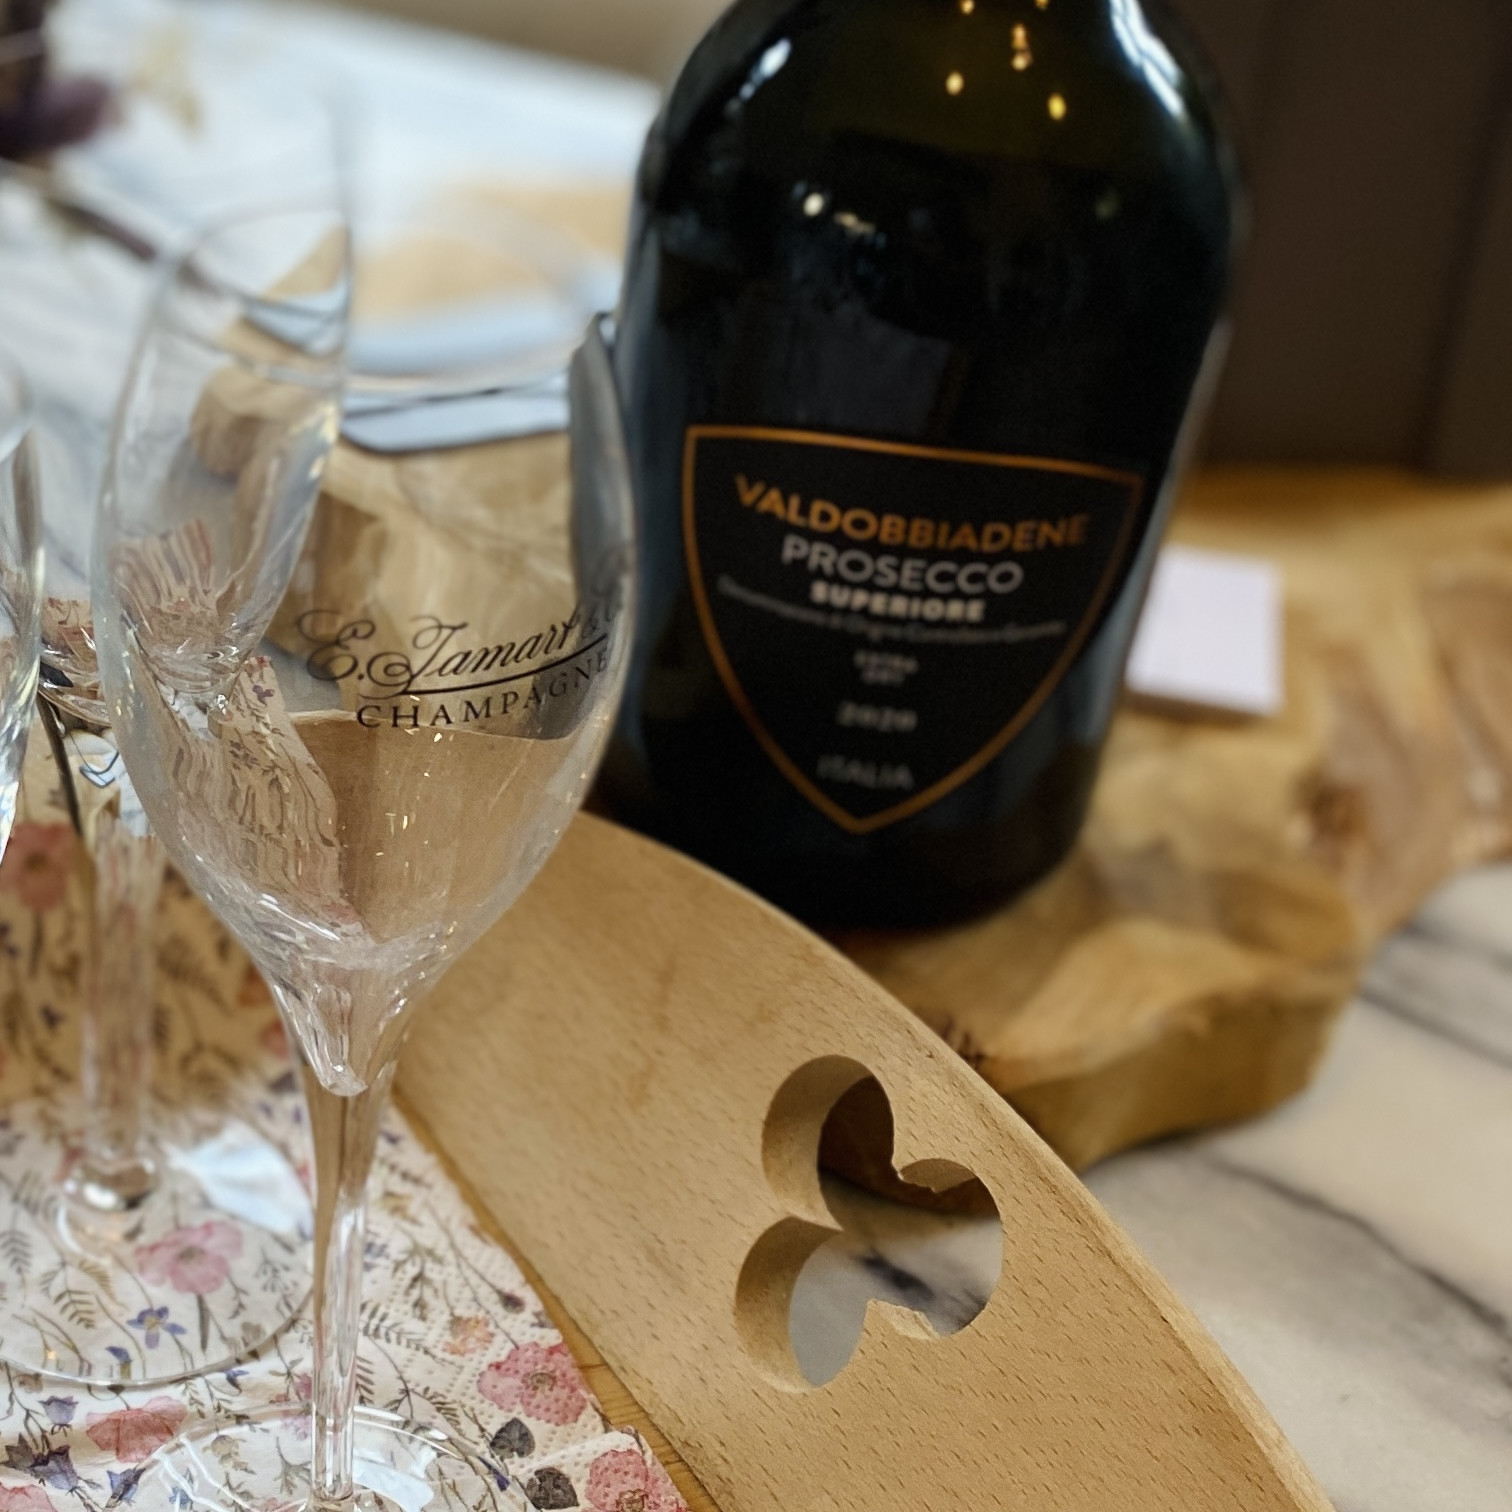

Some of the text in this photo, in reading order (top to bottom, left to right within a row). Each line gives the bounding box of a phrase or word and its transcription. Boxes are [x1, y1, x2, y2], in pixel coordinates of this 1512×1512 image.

[735, 473, 1090, 553] VALDOBBIADENE
[781, 533, 1025, 594] PROSECCO
[809, 579, 987, 623] SUPERIORE
[356, 647, 608, 729] CHAMPAGNE
